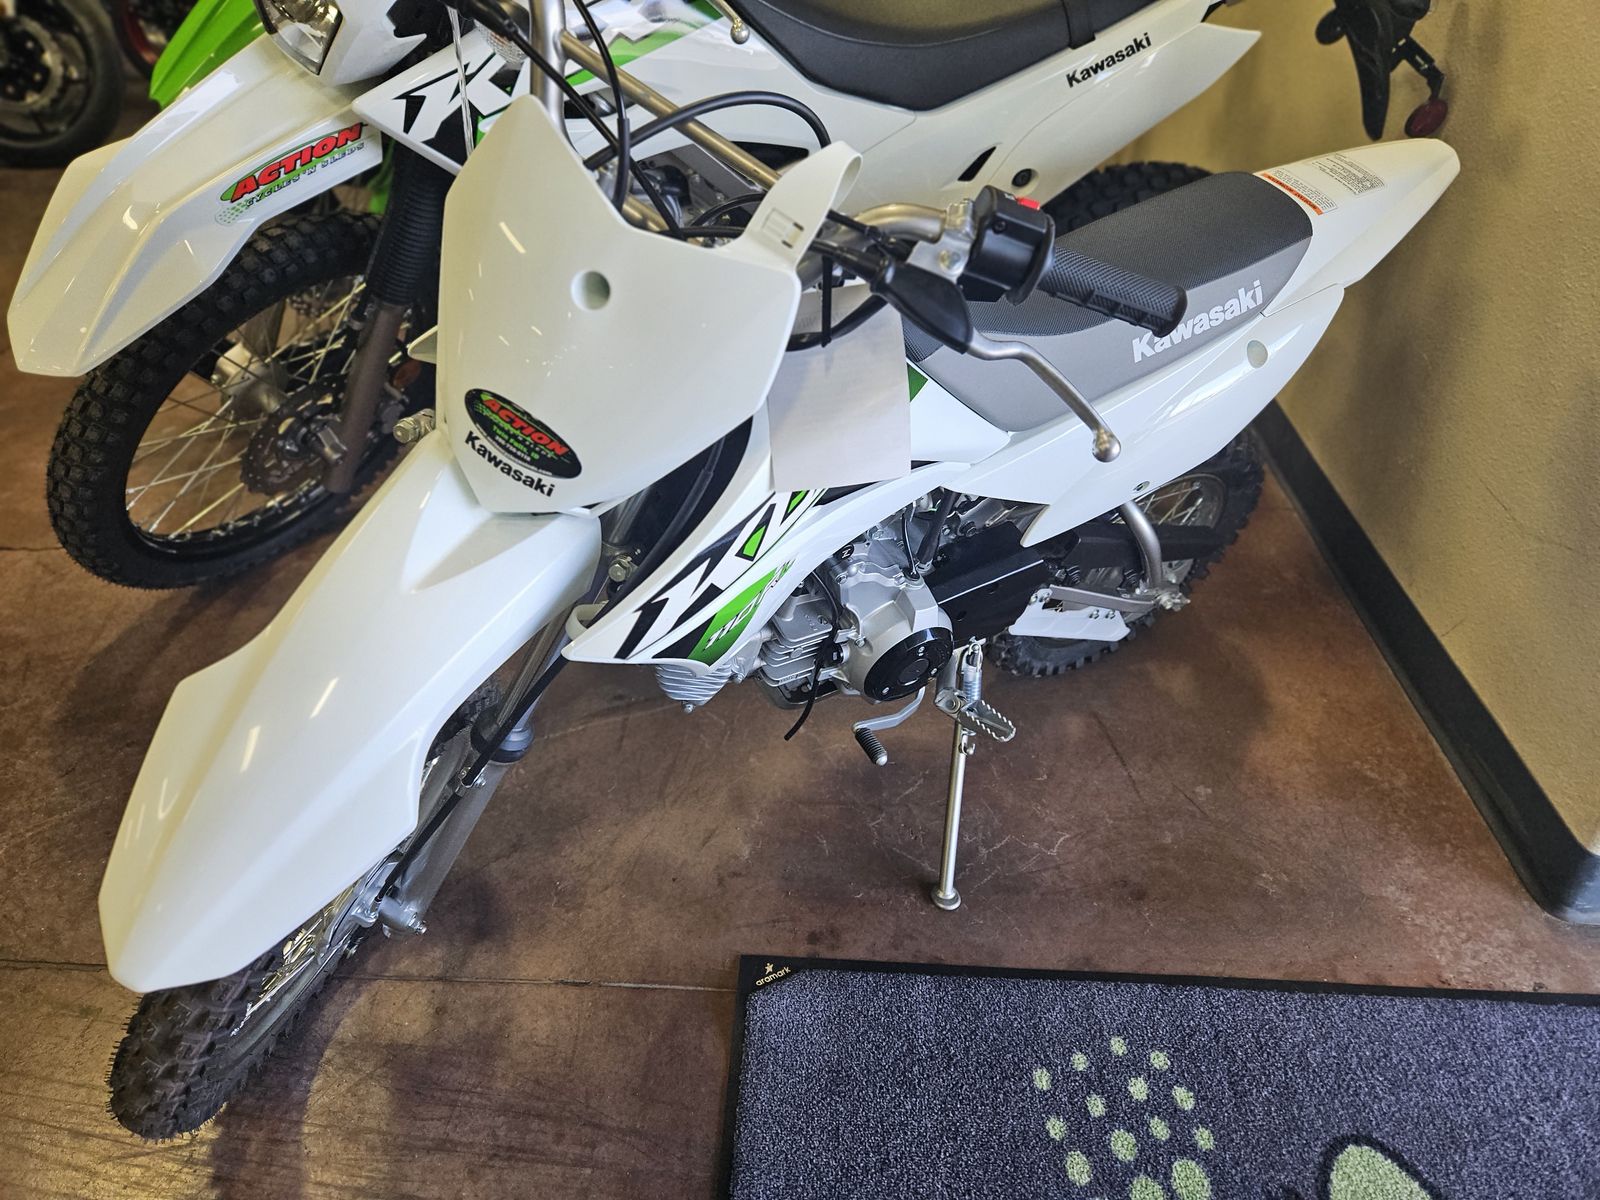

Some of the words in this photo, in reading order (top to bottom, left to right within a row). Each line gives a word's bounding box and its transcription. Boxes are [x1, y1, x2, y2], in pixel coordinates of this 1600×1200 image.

[1066, 32, 1152, 88] Kawasaki
[230, 122, 365, 203] ACTION
[1132, 280, 1263, 363] Kawasaki
[482, 398, 570, 456] ACTION
[465, 430, 556, 497] Kawasaki
[755, 966, 791, 986] aramark
